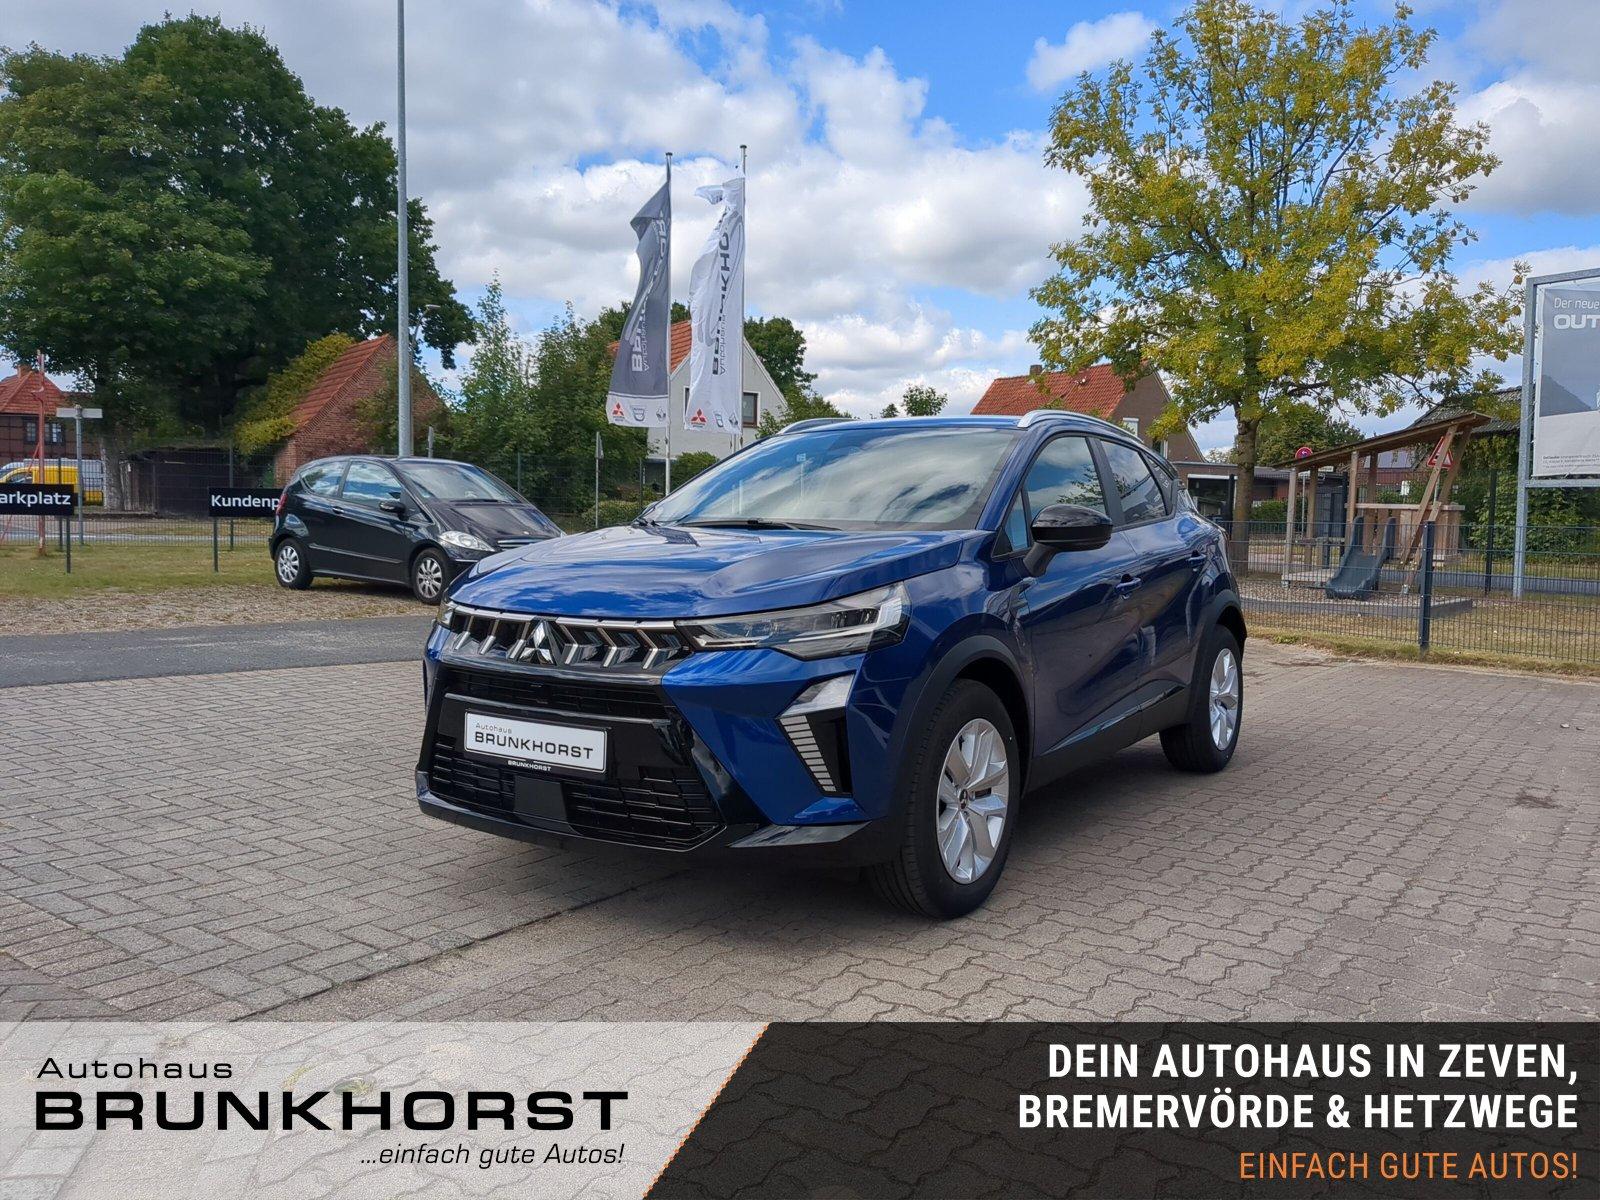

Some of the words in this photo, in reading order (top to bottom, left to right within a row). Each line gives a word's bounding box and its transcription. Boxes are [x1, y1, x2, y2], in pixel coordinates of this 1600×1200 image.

[1554, 297, 1573, 309] Der
[1574, 299, 1600, 310] neue
[211, 494, 280, 511] Kundenp
[476, 724, 512, 734] Autohaus
[475, 732, 593, 759] BRUNKHORST
[508, 760, 551, 771] BRUNKHORST
